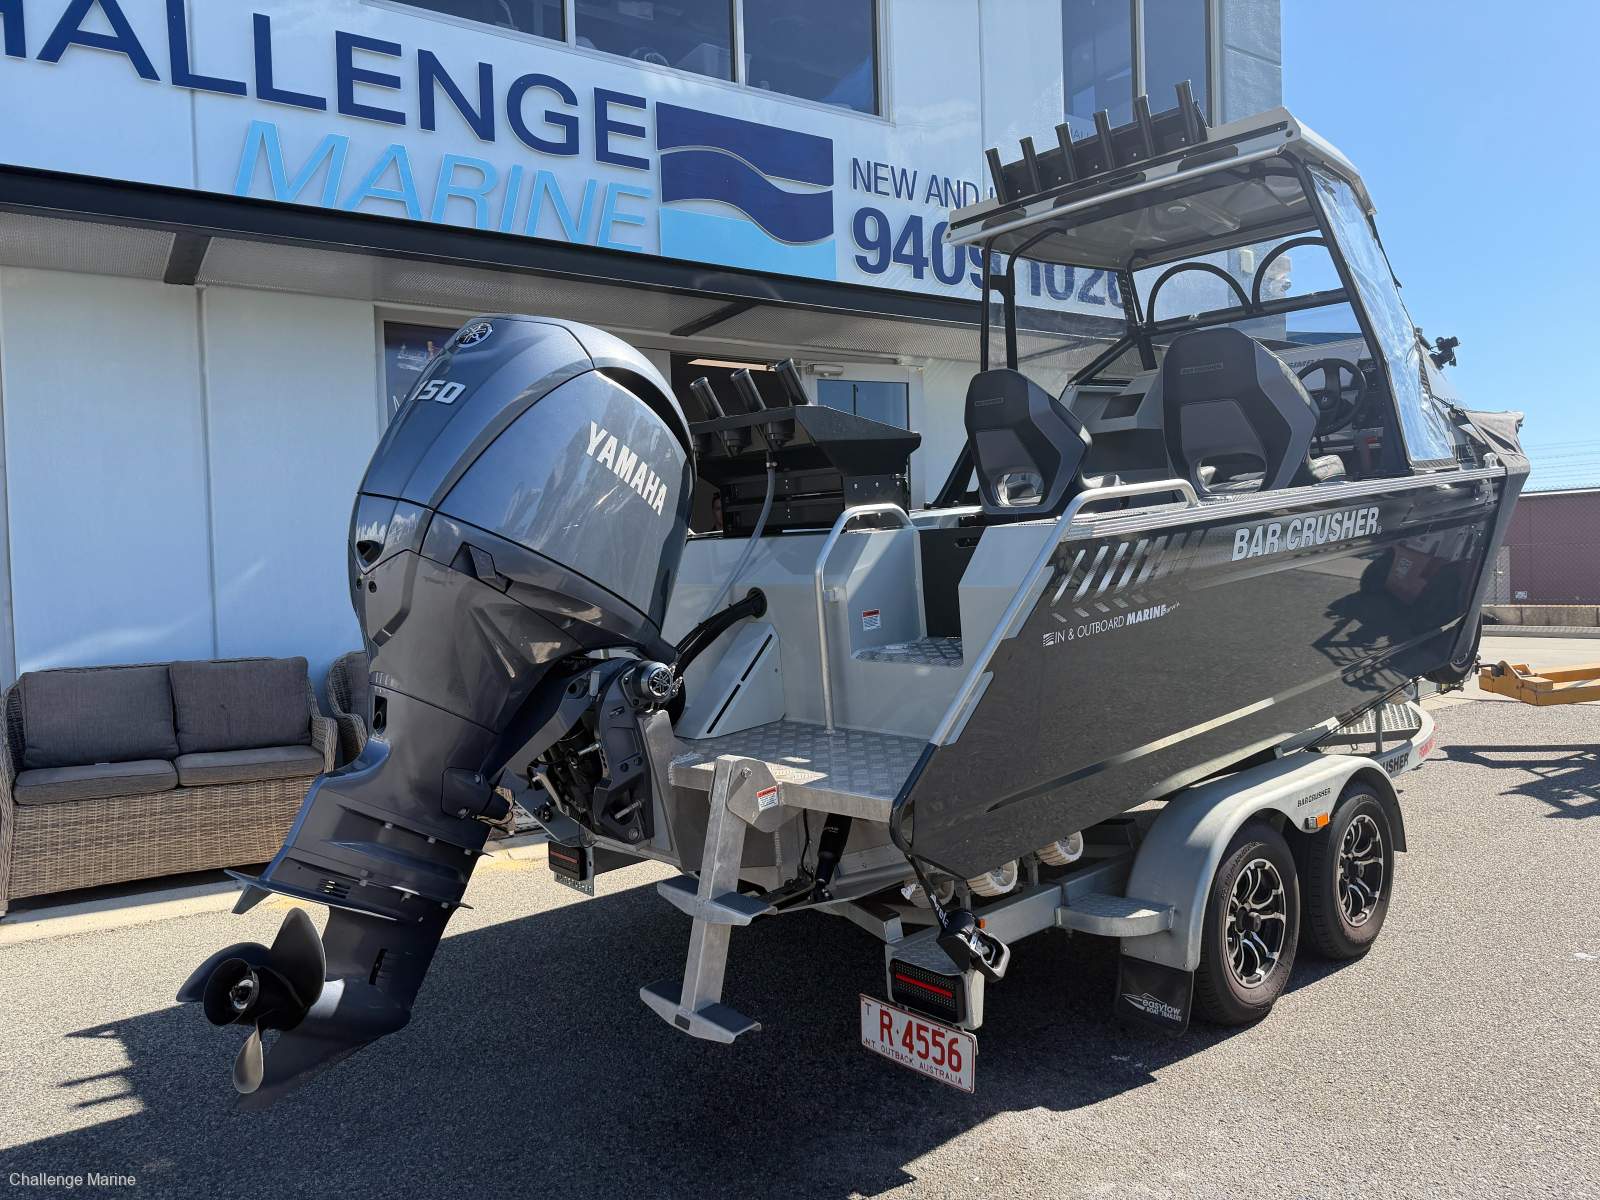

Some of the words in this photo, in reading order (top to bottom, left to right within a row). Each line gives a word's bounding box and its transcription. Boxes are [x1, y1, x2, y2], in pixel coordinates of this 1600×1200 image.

[234, 119, 653, 253] MARINE
[851, 157, 918, 201] NEW
[925, 174, 980, 209] AND
[585, 421, 669, 516] YAMAHA
[1231, 520, 1281, 561] BAR
[1286, 506, 1380, 551] CRUSHER
[1055, 629, 1066, 645] IN
[1067, 628, 1075, 641] &
[1077, 615, 1126, 639] OUTBOARD
[1126, 604, 1167, 626] MARINE
[864, 1002, 872, 1016] T
[880, 1045, 914, 1066] OUTBACK
[919, 1061, 963, 1086] AUSTRALIA
